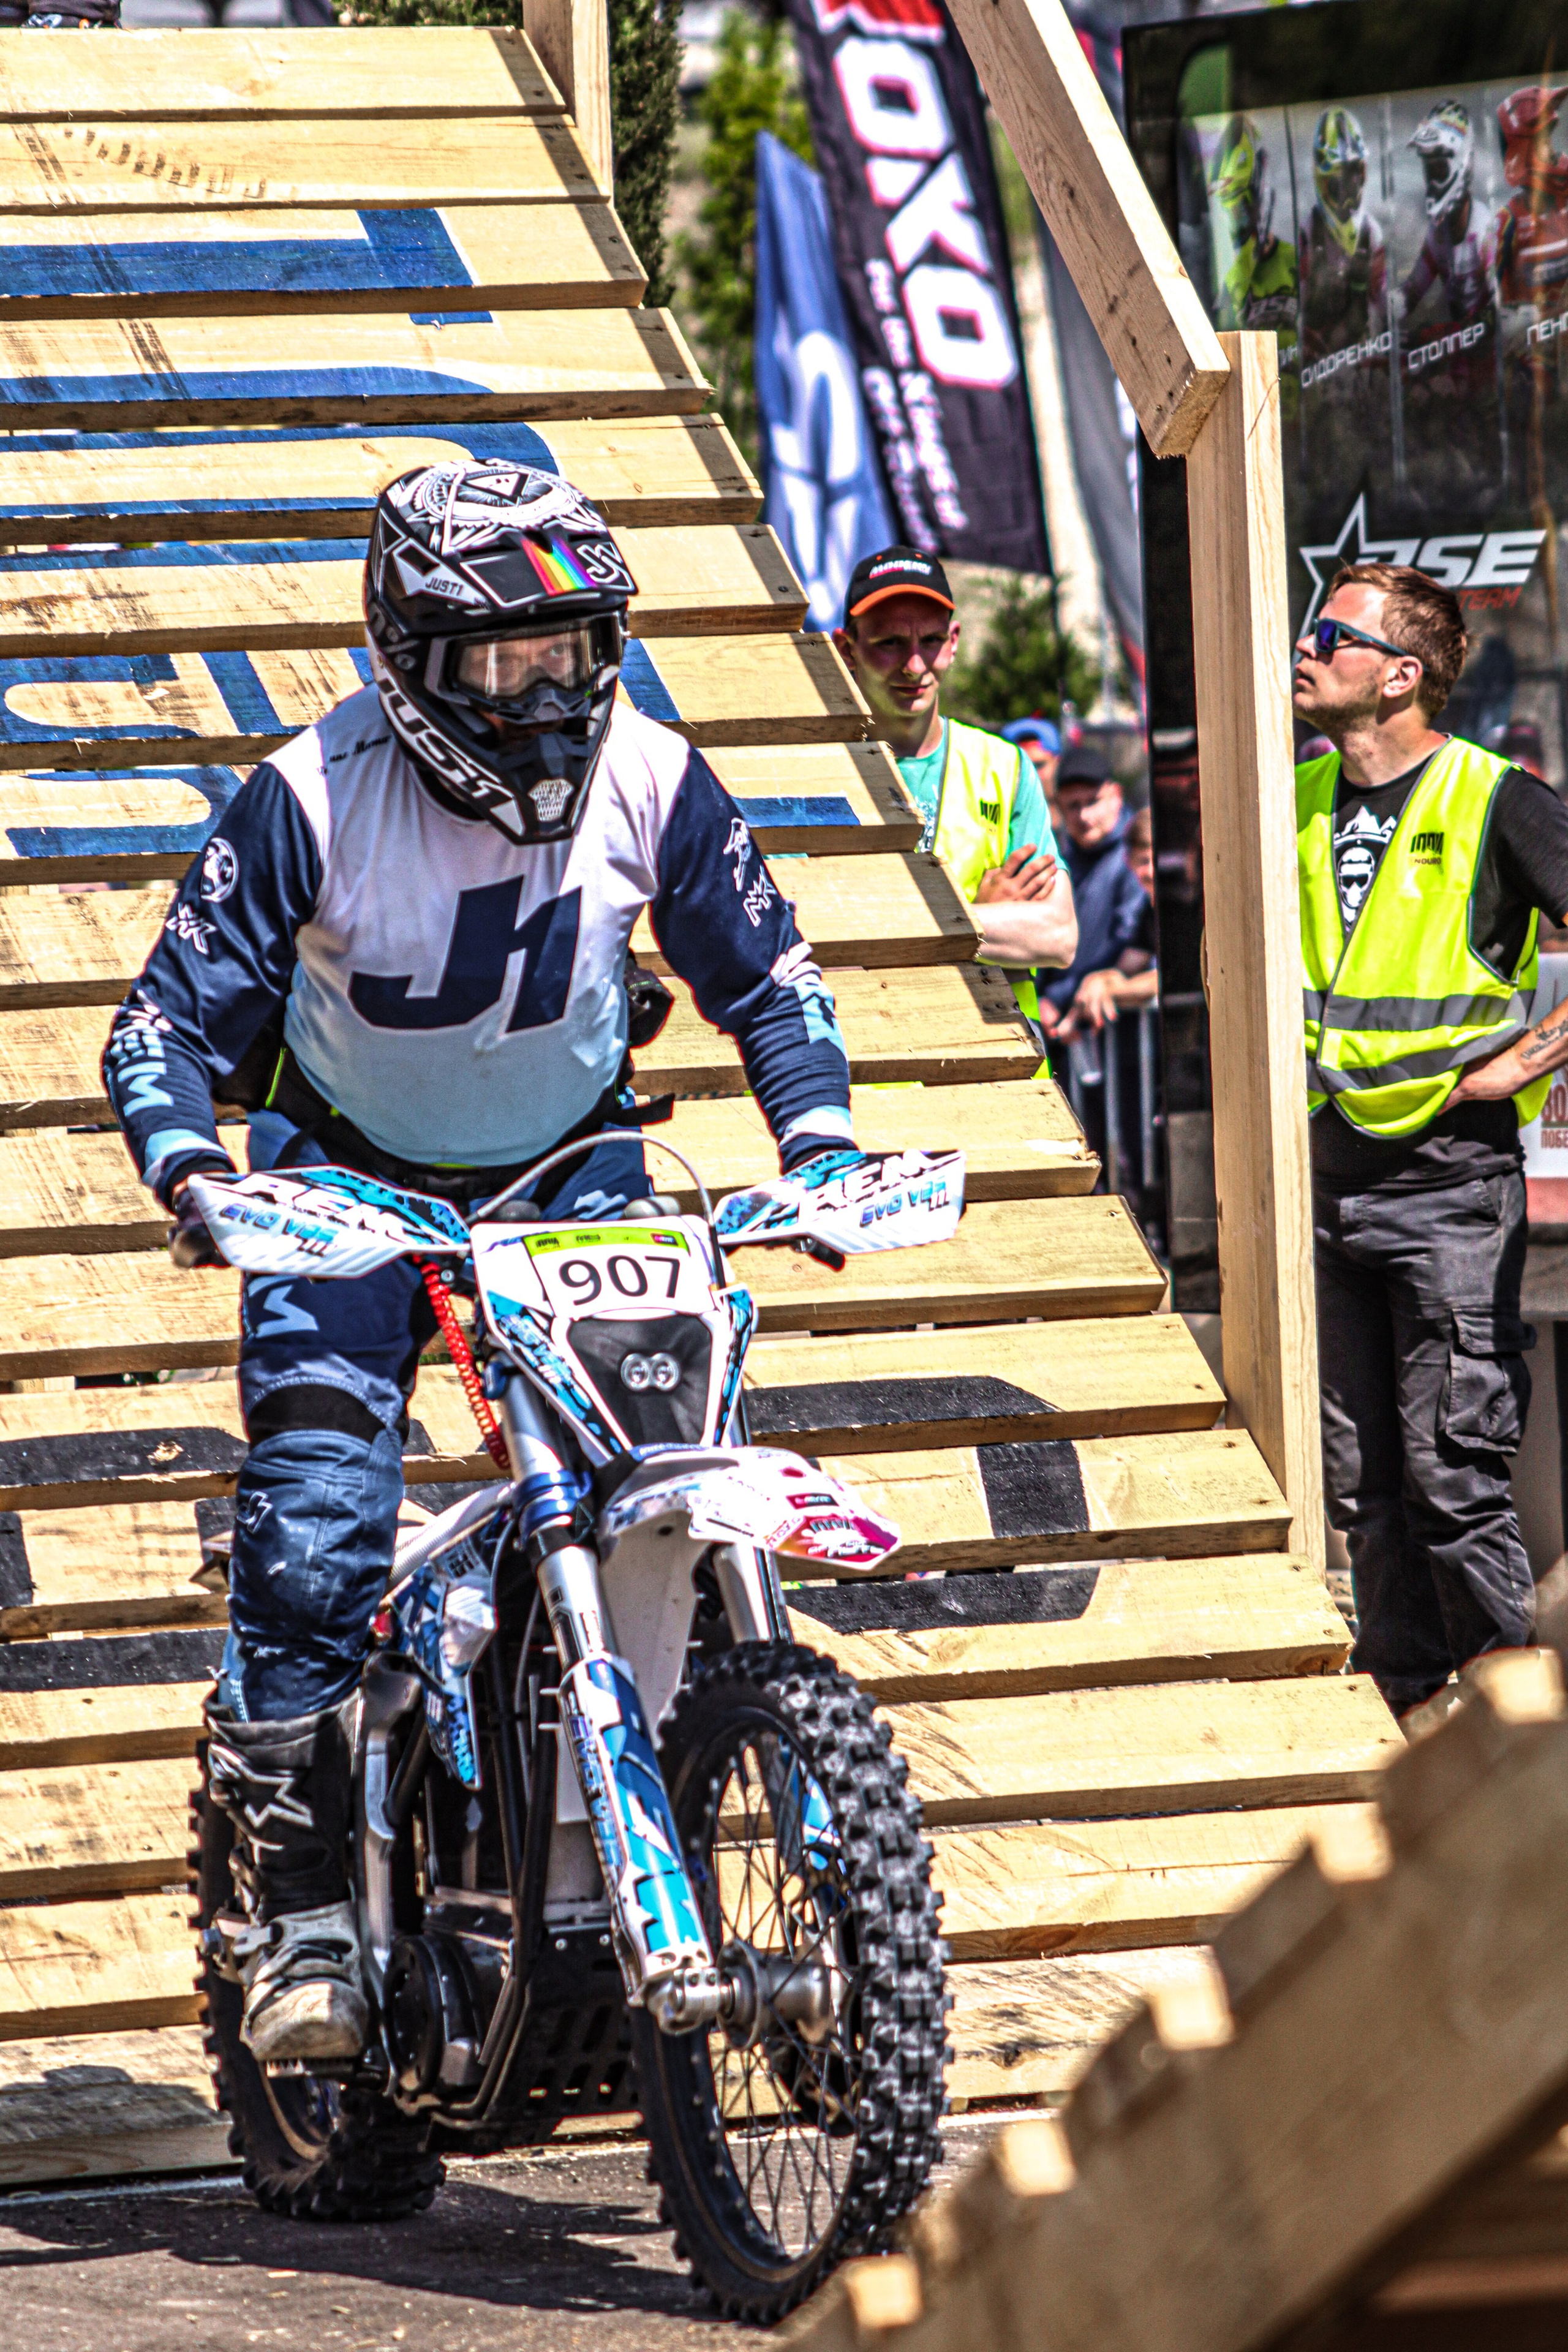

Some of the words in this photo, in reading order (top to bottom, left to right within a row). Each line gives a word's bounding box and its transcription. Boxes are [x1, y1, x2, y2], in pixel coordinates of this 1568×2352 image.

[425, 577, 464, 596] JUST1
[859, 1193, 903, 1228] EVO
[558, 1254, 680, 1306] 907
